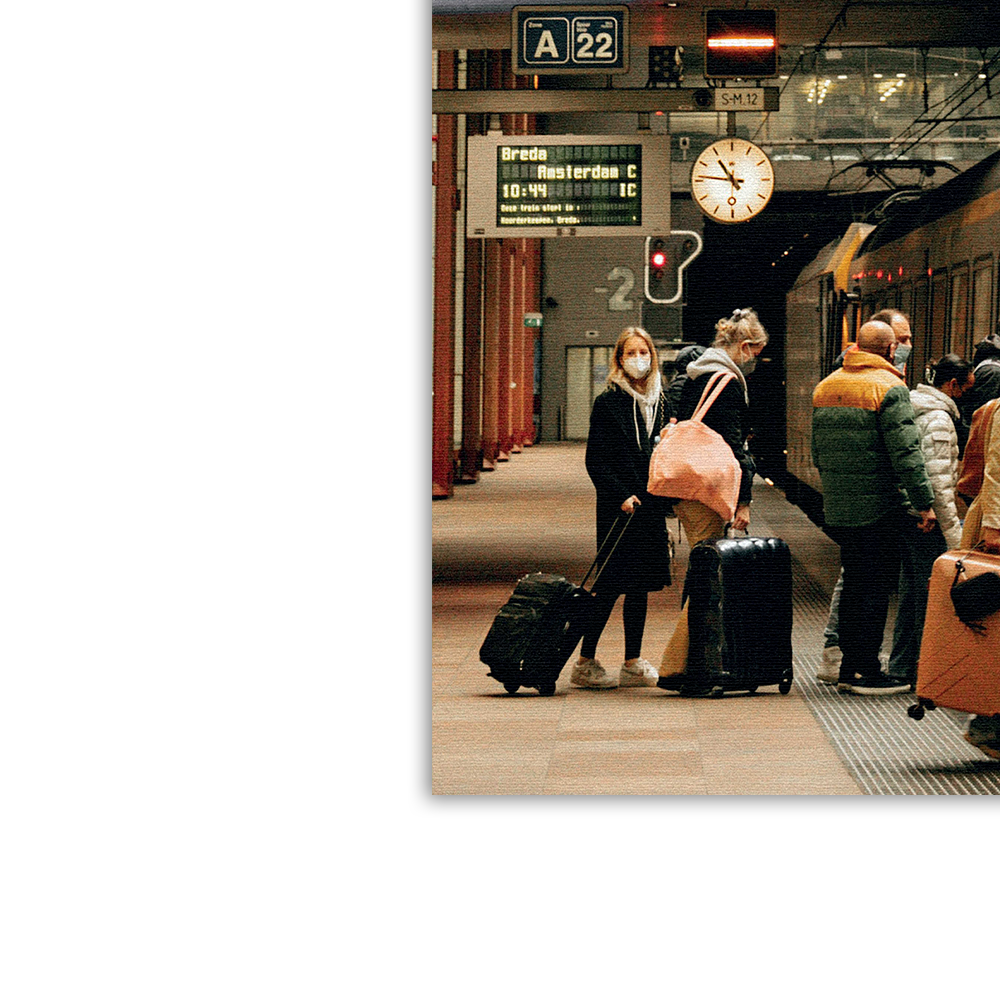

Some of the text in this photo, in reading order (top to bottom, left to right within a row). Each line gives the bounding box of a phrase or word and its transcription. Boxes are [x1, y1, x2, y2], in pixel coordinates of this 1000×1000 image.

[534, 30, 559, 58] A
[577, 32, 613, 58] 22
[501, 146, 547, 161] Breda
[537, 164, 637, 179] Amsterdam C
[502, 183, 548, 198] 10:44
[619, 183, 637, 197] IC
